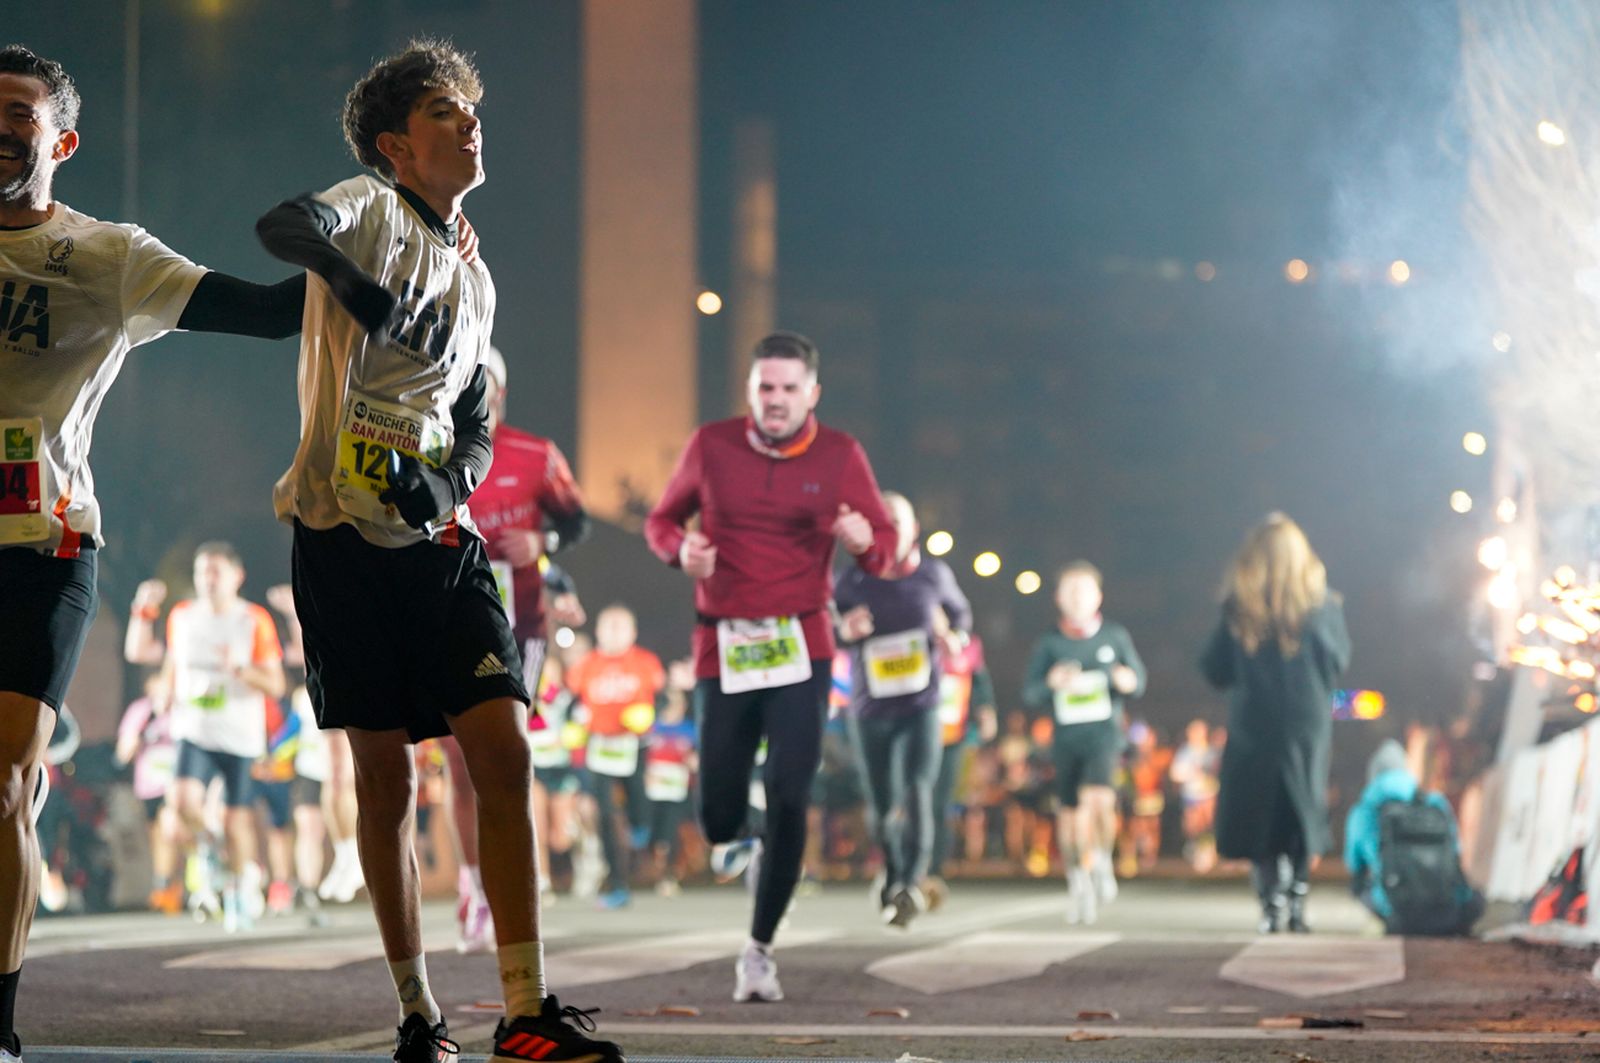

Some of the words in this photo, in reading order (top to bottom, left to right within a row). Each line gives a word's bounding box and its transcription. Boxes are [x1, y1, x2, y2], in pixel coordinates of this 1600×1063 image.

[350, 422, 376, 440] SAN
[379, 430, 421, 452] ANTÓN
[368, 413, 405, 432] NOCHE
[407, 423, 422, 437] DE
